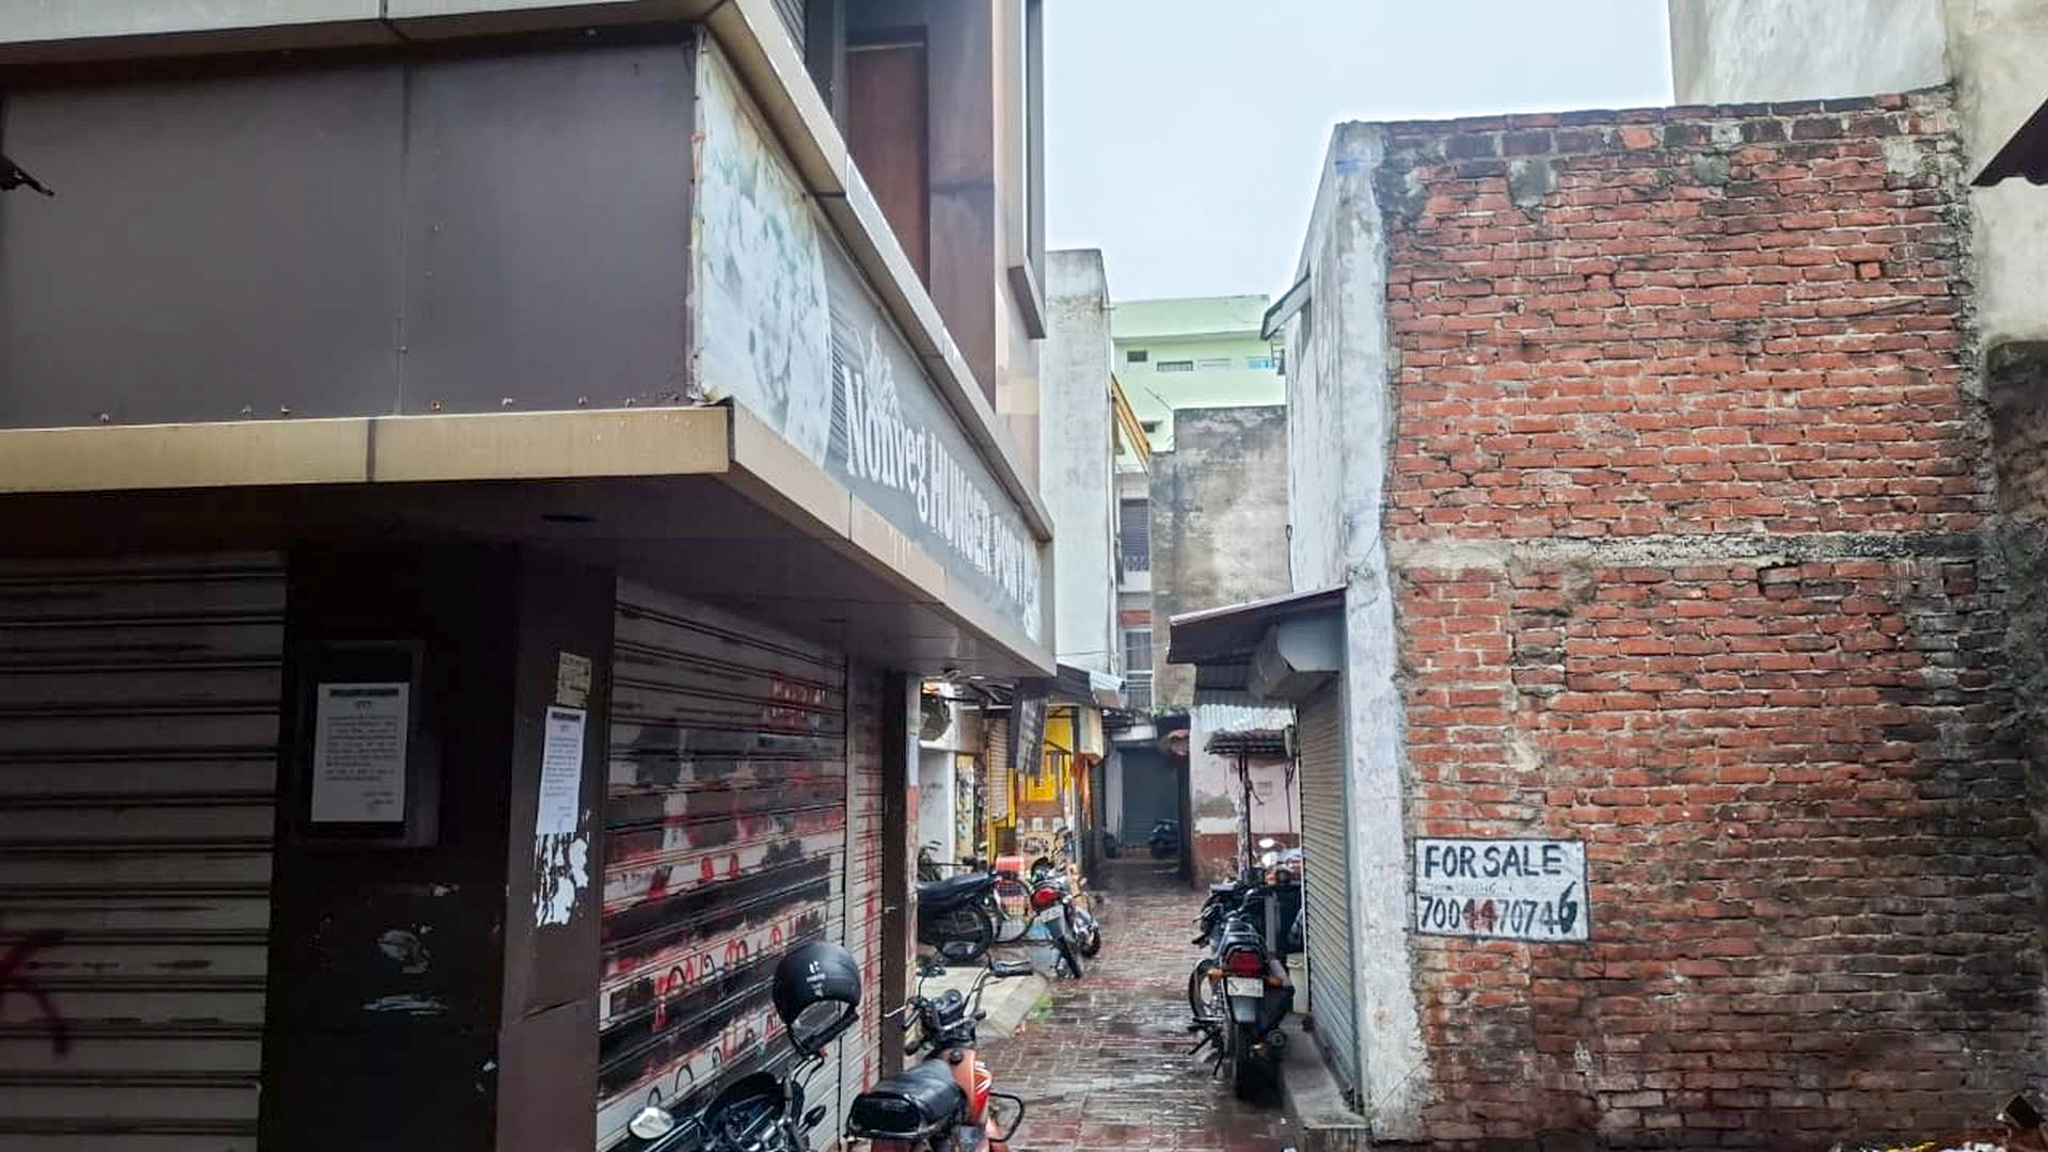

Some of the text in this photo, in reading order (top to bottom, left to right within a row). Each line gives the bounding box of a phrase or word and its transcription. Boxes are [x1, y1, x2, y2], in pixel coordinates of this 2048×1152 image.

[843, 365, 928, 523] Nonveg
[930, 432, 991, 574] HUNGER
[1424, 844, 1562, 879] FOR SALE
[1420, 881, 1578, 935] 7004470746
